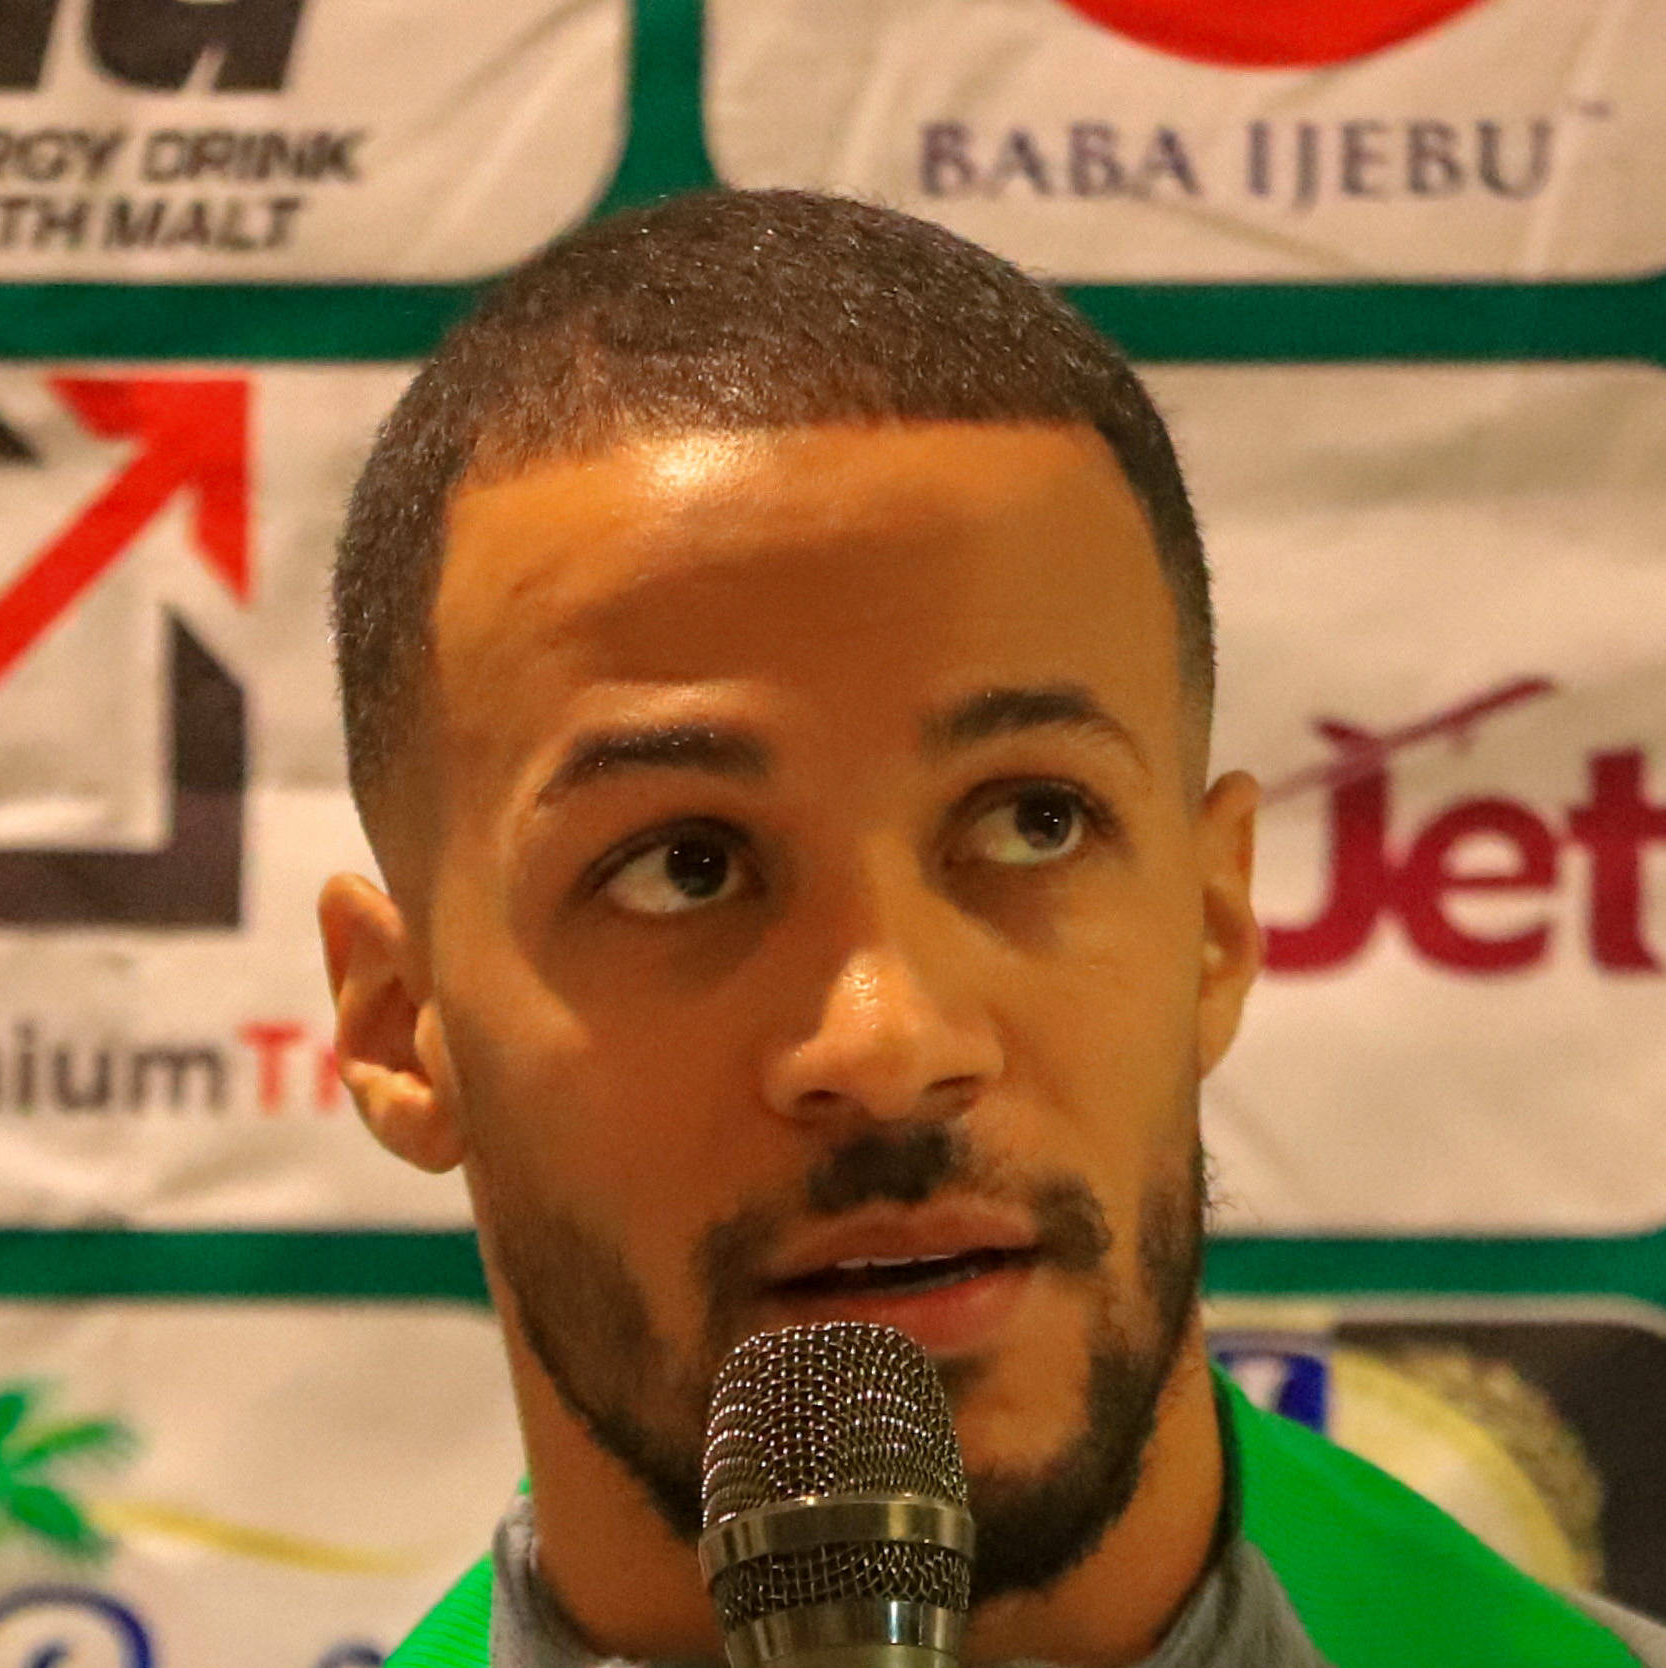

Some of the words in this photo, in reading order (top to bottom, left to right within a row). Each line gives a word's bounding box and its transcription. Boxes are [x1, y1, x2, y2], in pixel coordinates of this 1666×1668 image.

[141, 126, 365, 183] DRINK
[918, 119, 1205, 199] BABA
[1244, 119, 1555, 215] IJEBU
[102, 195, 303, 249] MALT
